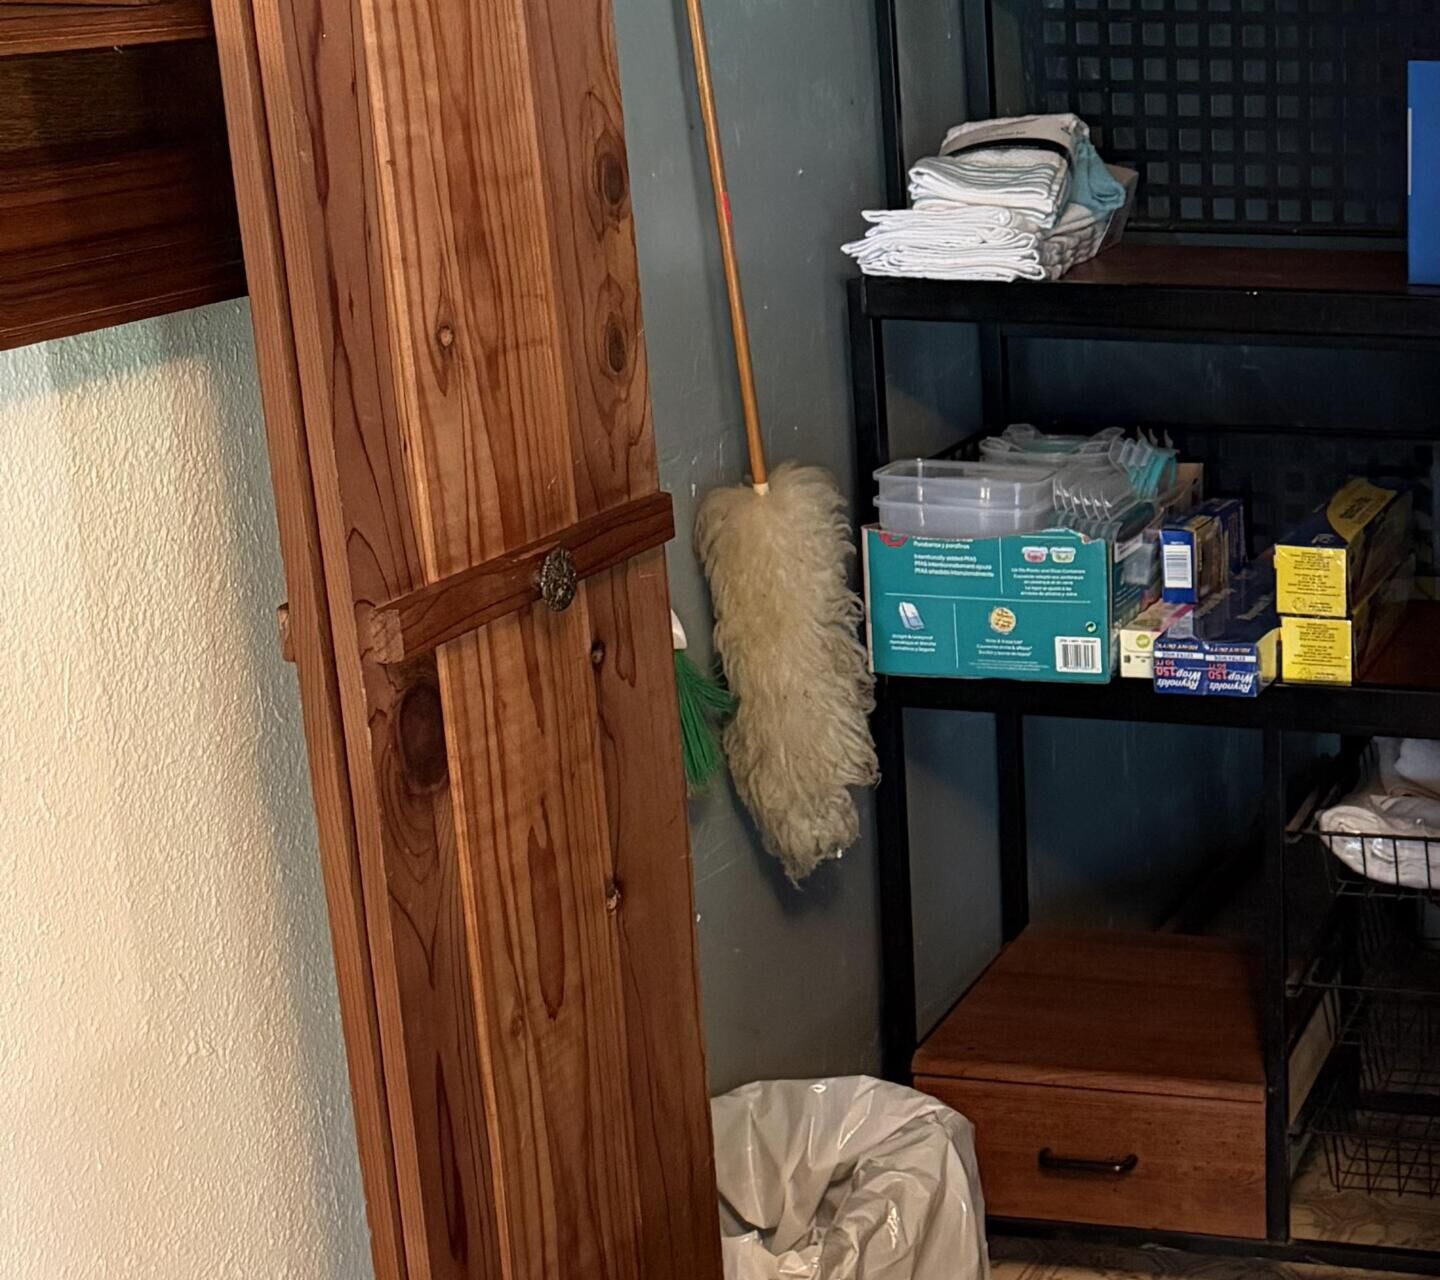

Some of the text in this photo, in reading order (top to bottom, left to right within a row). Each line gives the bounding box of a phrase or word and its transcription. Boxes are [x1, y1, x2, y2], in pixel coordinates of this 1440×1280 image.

[1156, 666, 1202, 682] Wrap 150
[1208, 670, 1254, 685] Wrap 150
[1156, 677, 1199, 690] Reynolds
[1209, 681, 1252, 693] Reynolds
